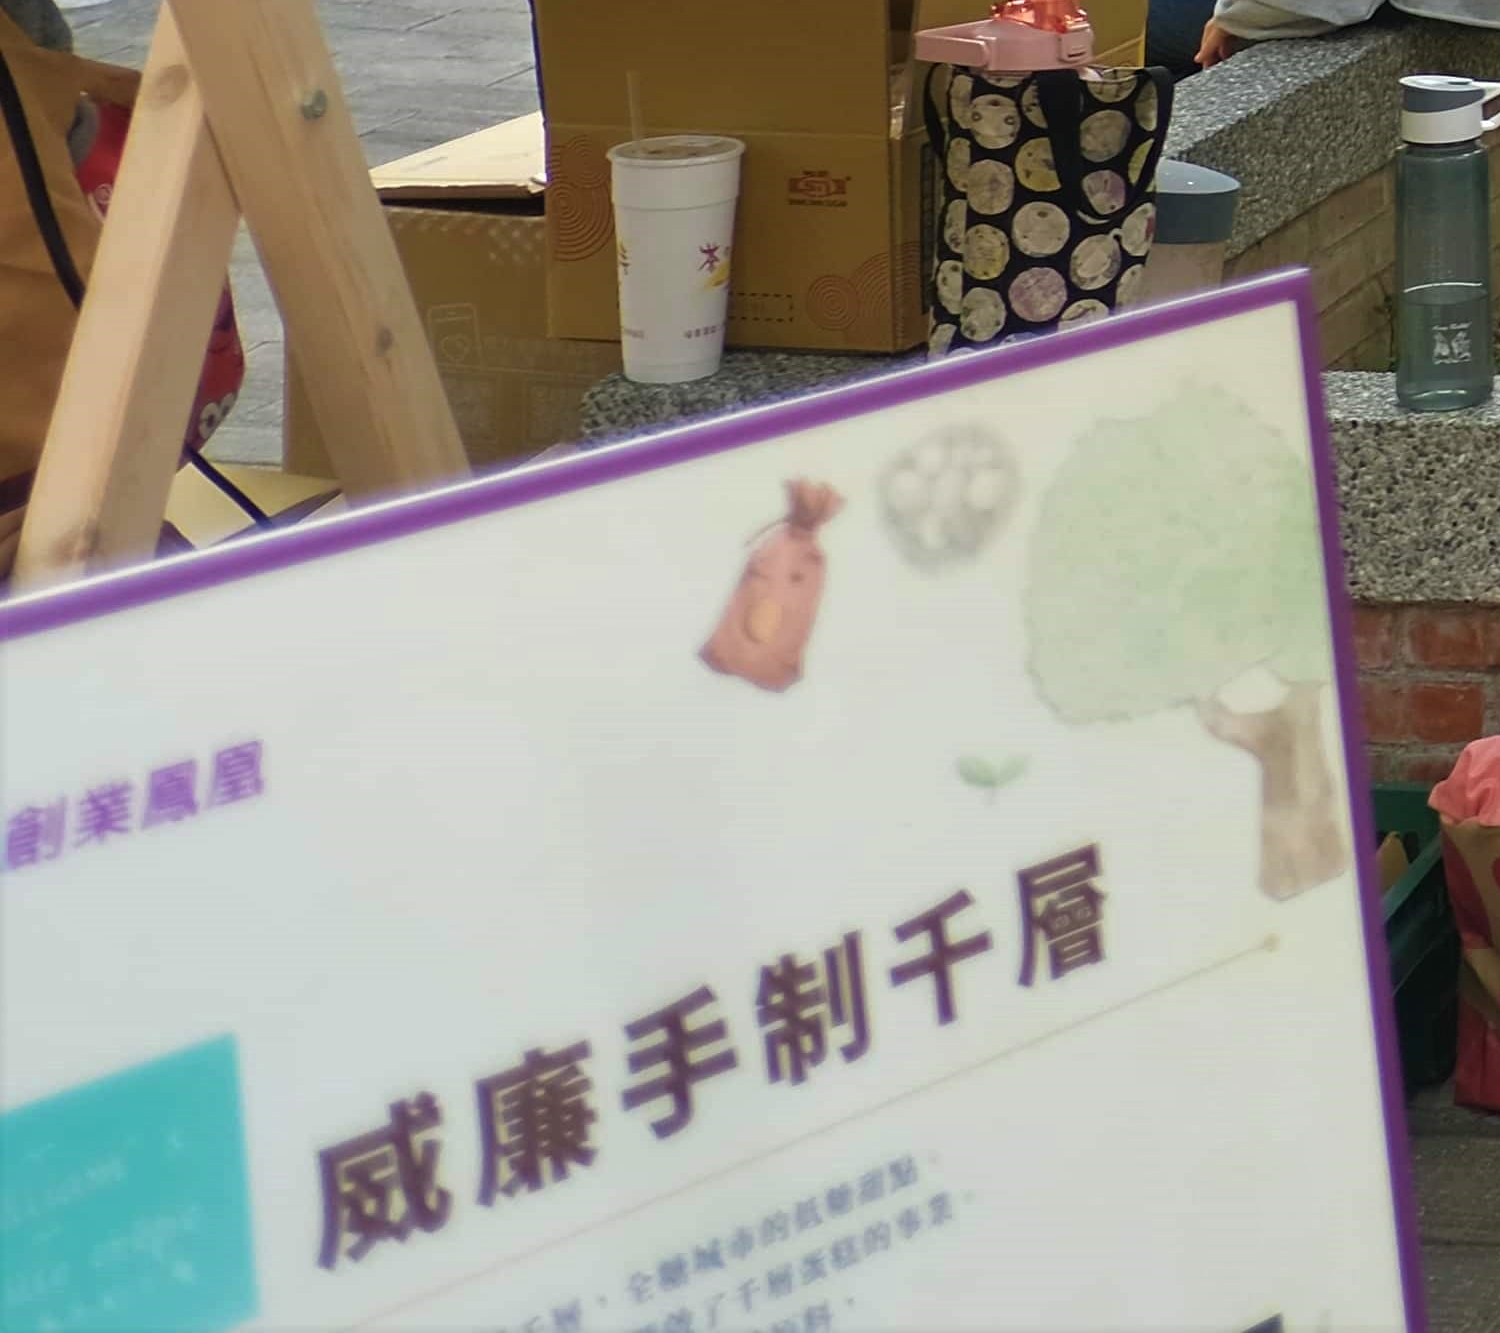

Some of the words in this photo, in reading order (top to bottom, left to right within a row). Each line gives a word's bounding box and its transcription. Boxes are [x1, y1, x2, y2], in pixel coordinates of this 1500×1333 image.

[312, 841, 1110, 1271] 威廉手制千層
